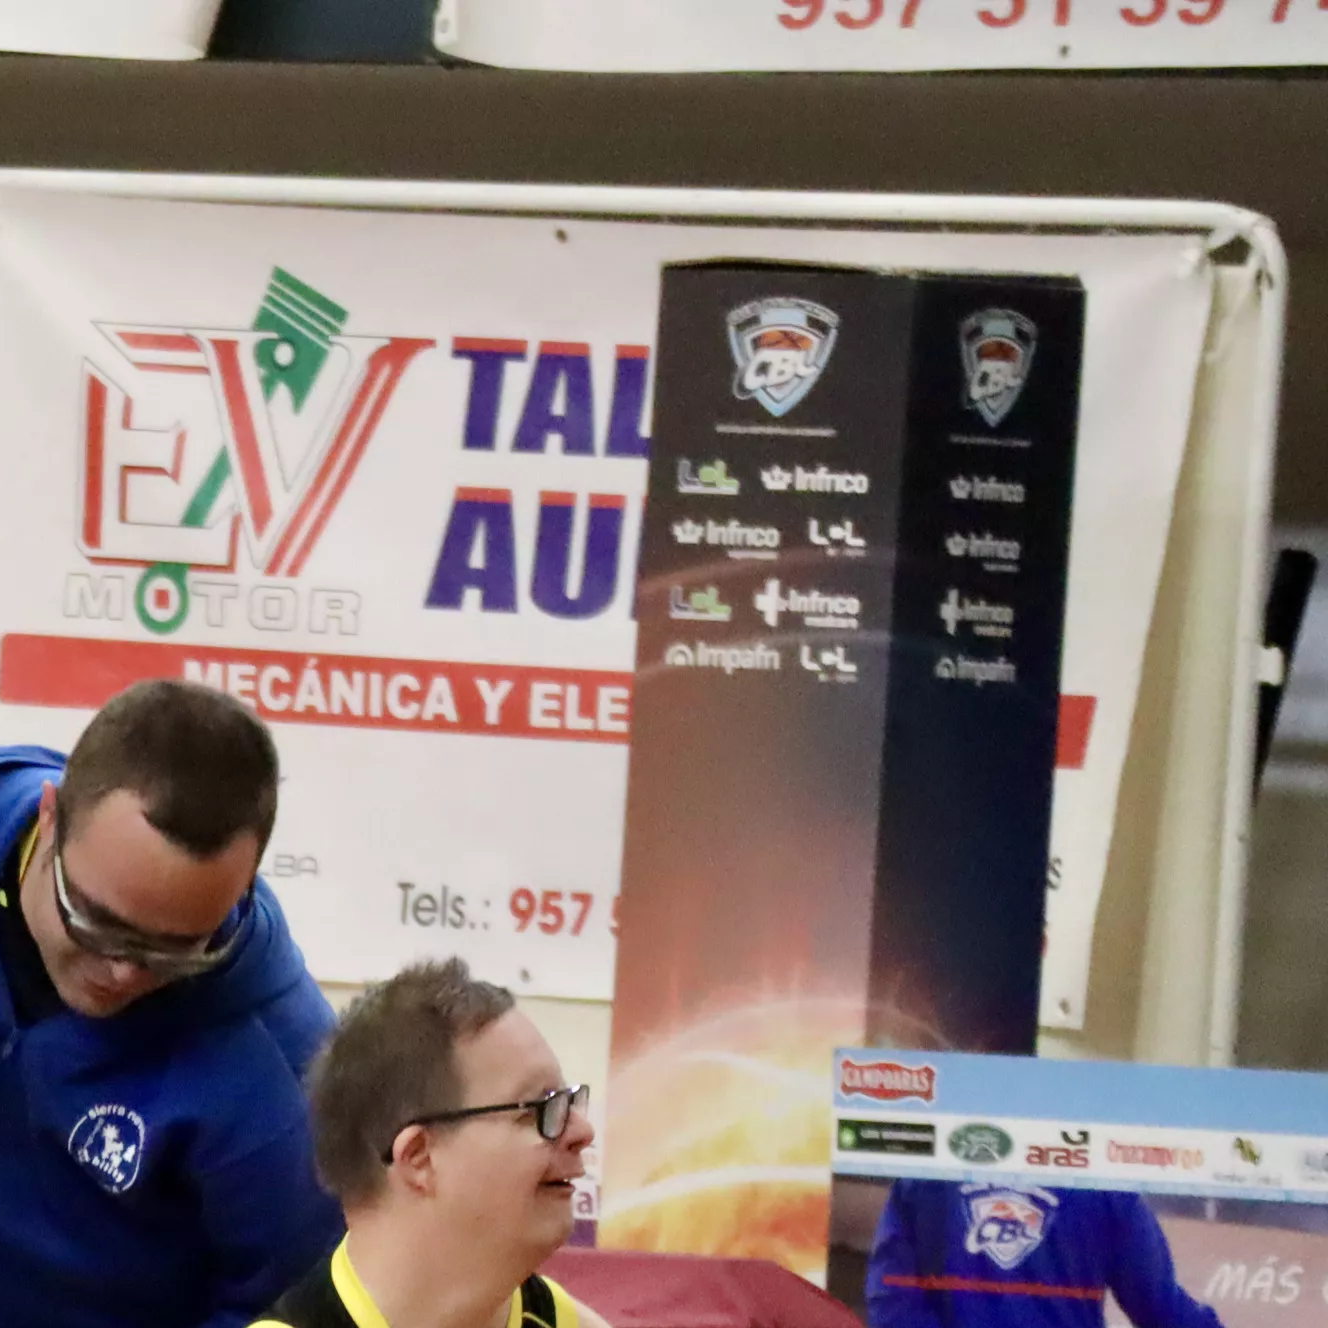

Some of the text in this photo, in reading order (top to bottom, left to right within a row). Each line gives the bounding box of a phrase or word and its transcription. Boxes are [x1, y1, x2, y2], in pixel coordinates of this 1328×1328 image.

[61, 559, 363, 636] MOTOR
[475, 678, 514, 726] Y
[397, 881, 492, 932] Tels.:
[508, 887, 594, 936] 957
[1204, 1254, 1304, 1305] MÁS
